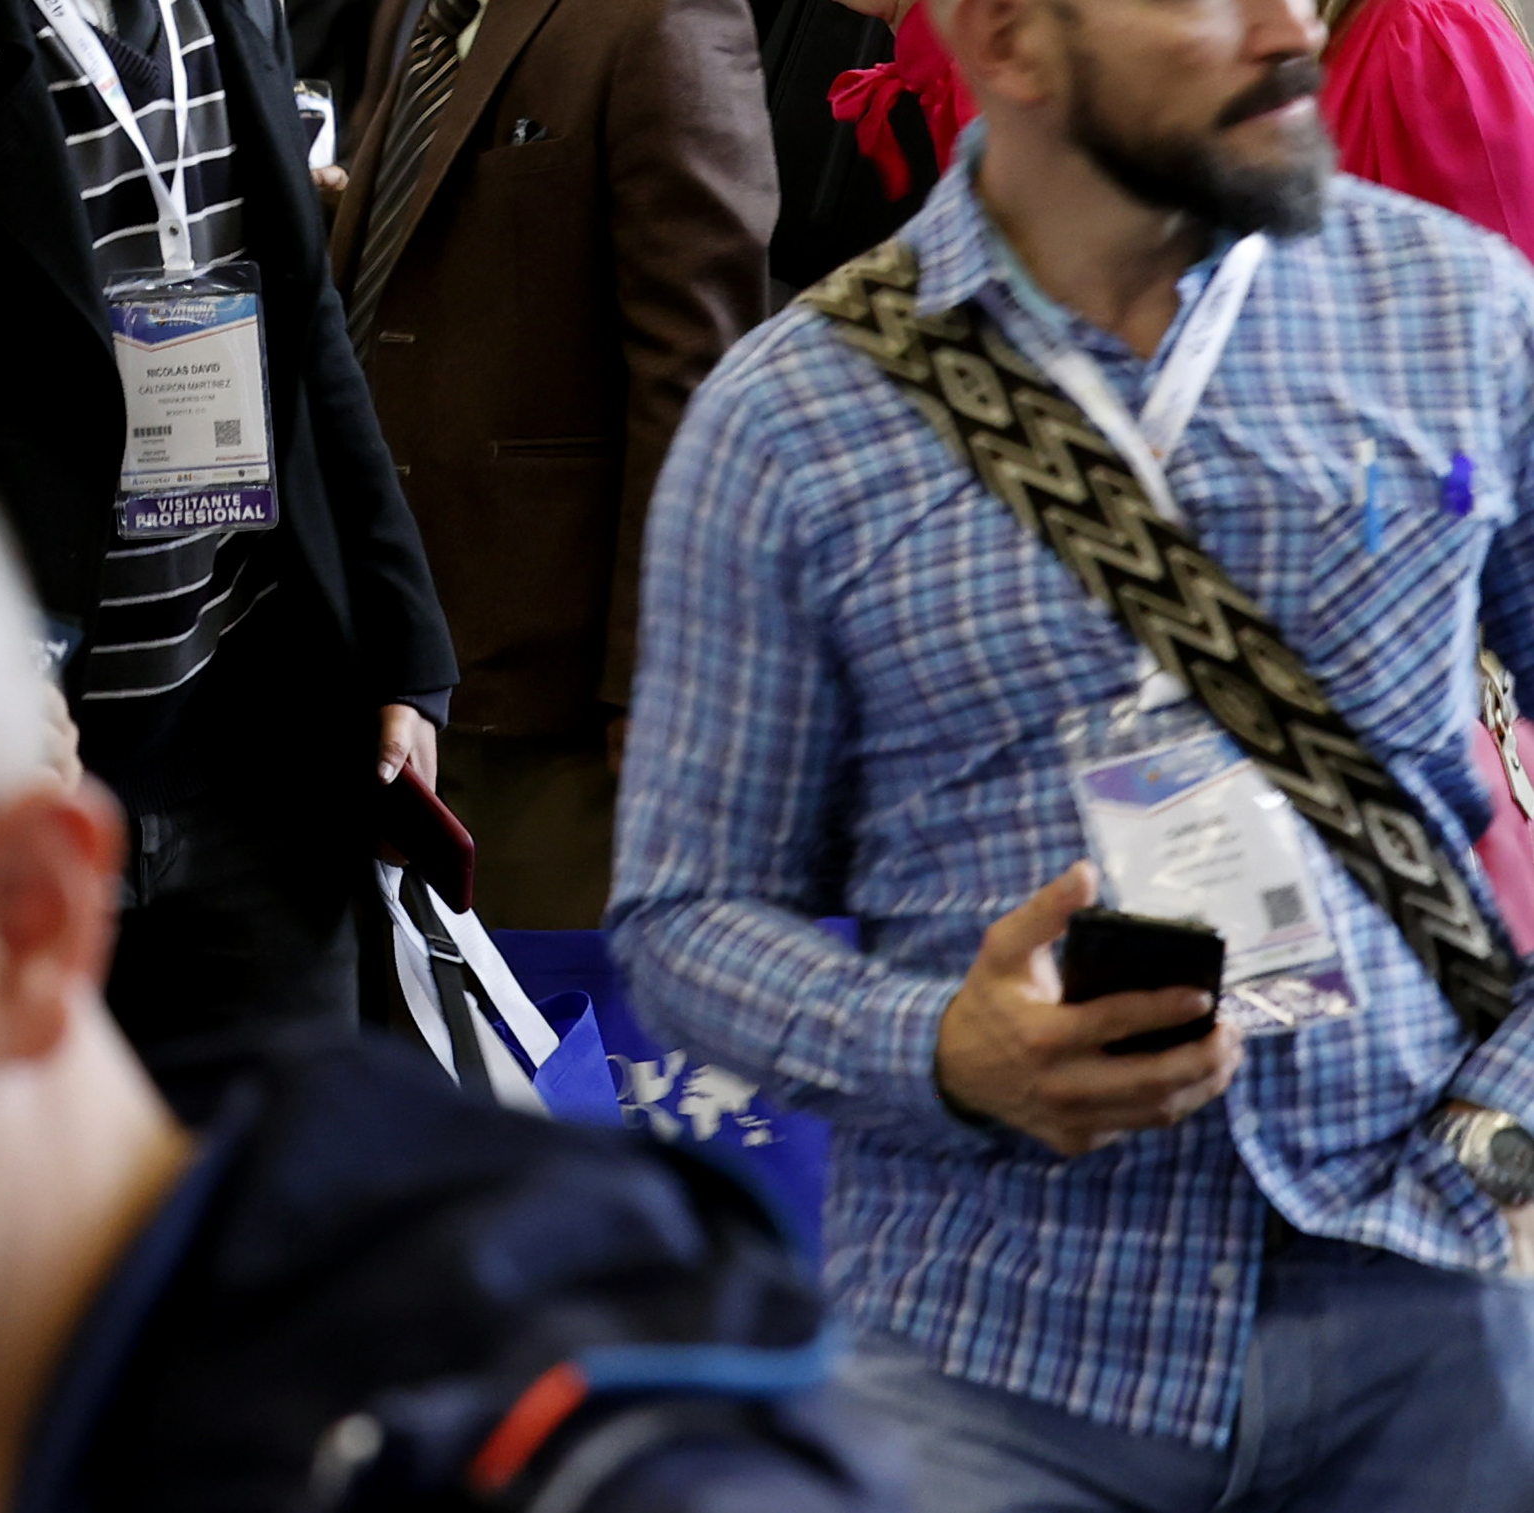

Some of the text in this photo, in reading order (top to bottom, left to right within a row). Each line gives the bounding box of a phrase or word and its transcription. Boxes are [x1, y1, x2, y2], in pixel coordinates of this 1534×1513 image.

[191, 362, 221, 375] DAVID
[156, 493, 241, 513] VISITANTE
[135, 504, 266, 529] PROFESIONAL
